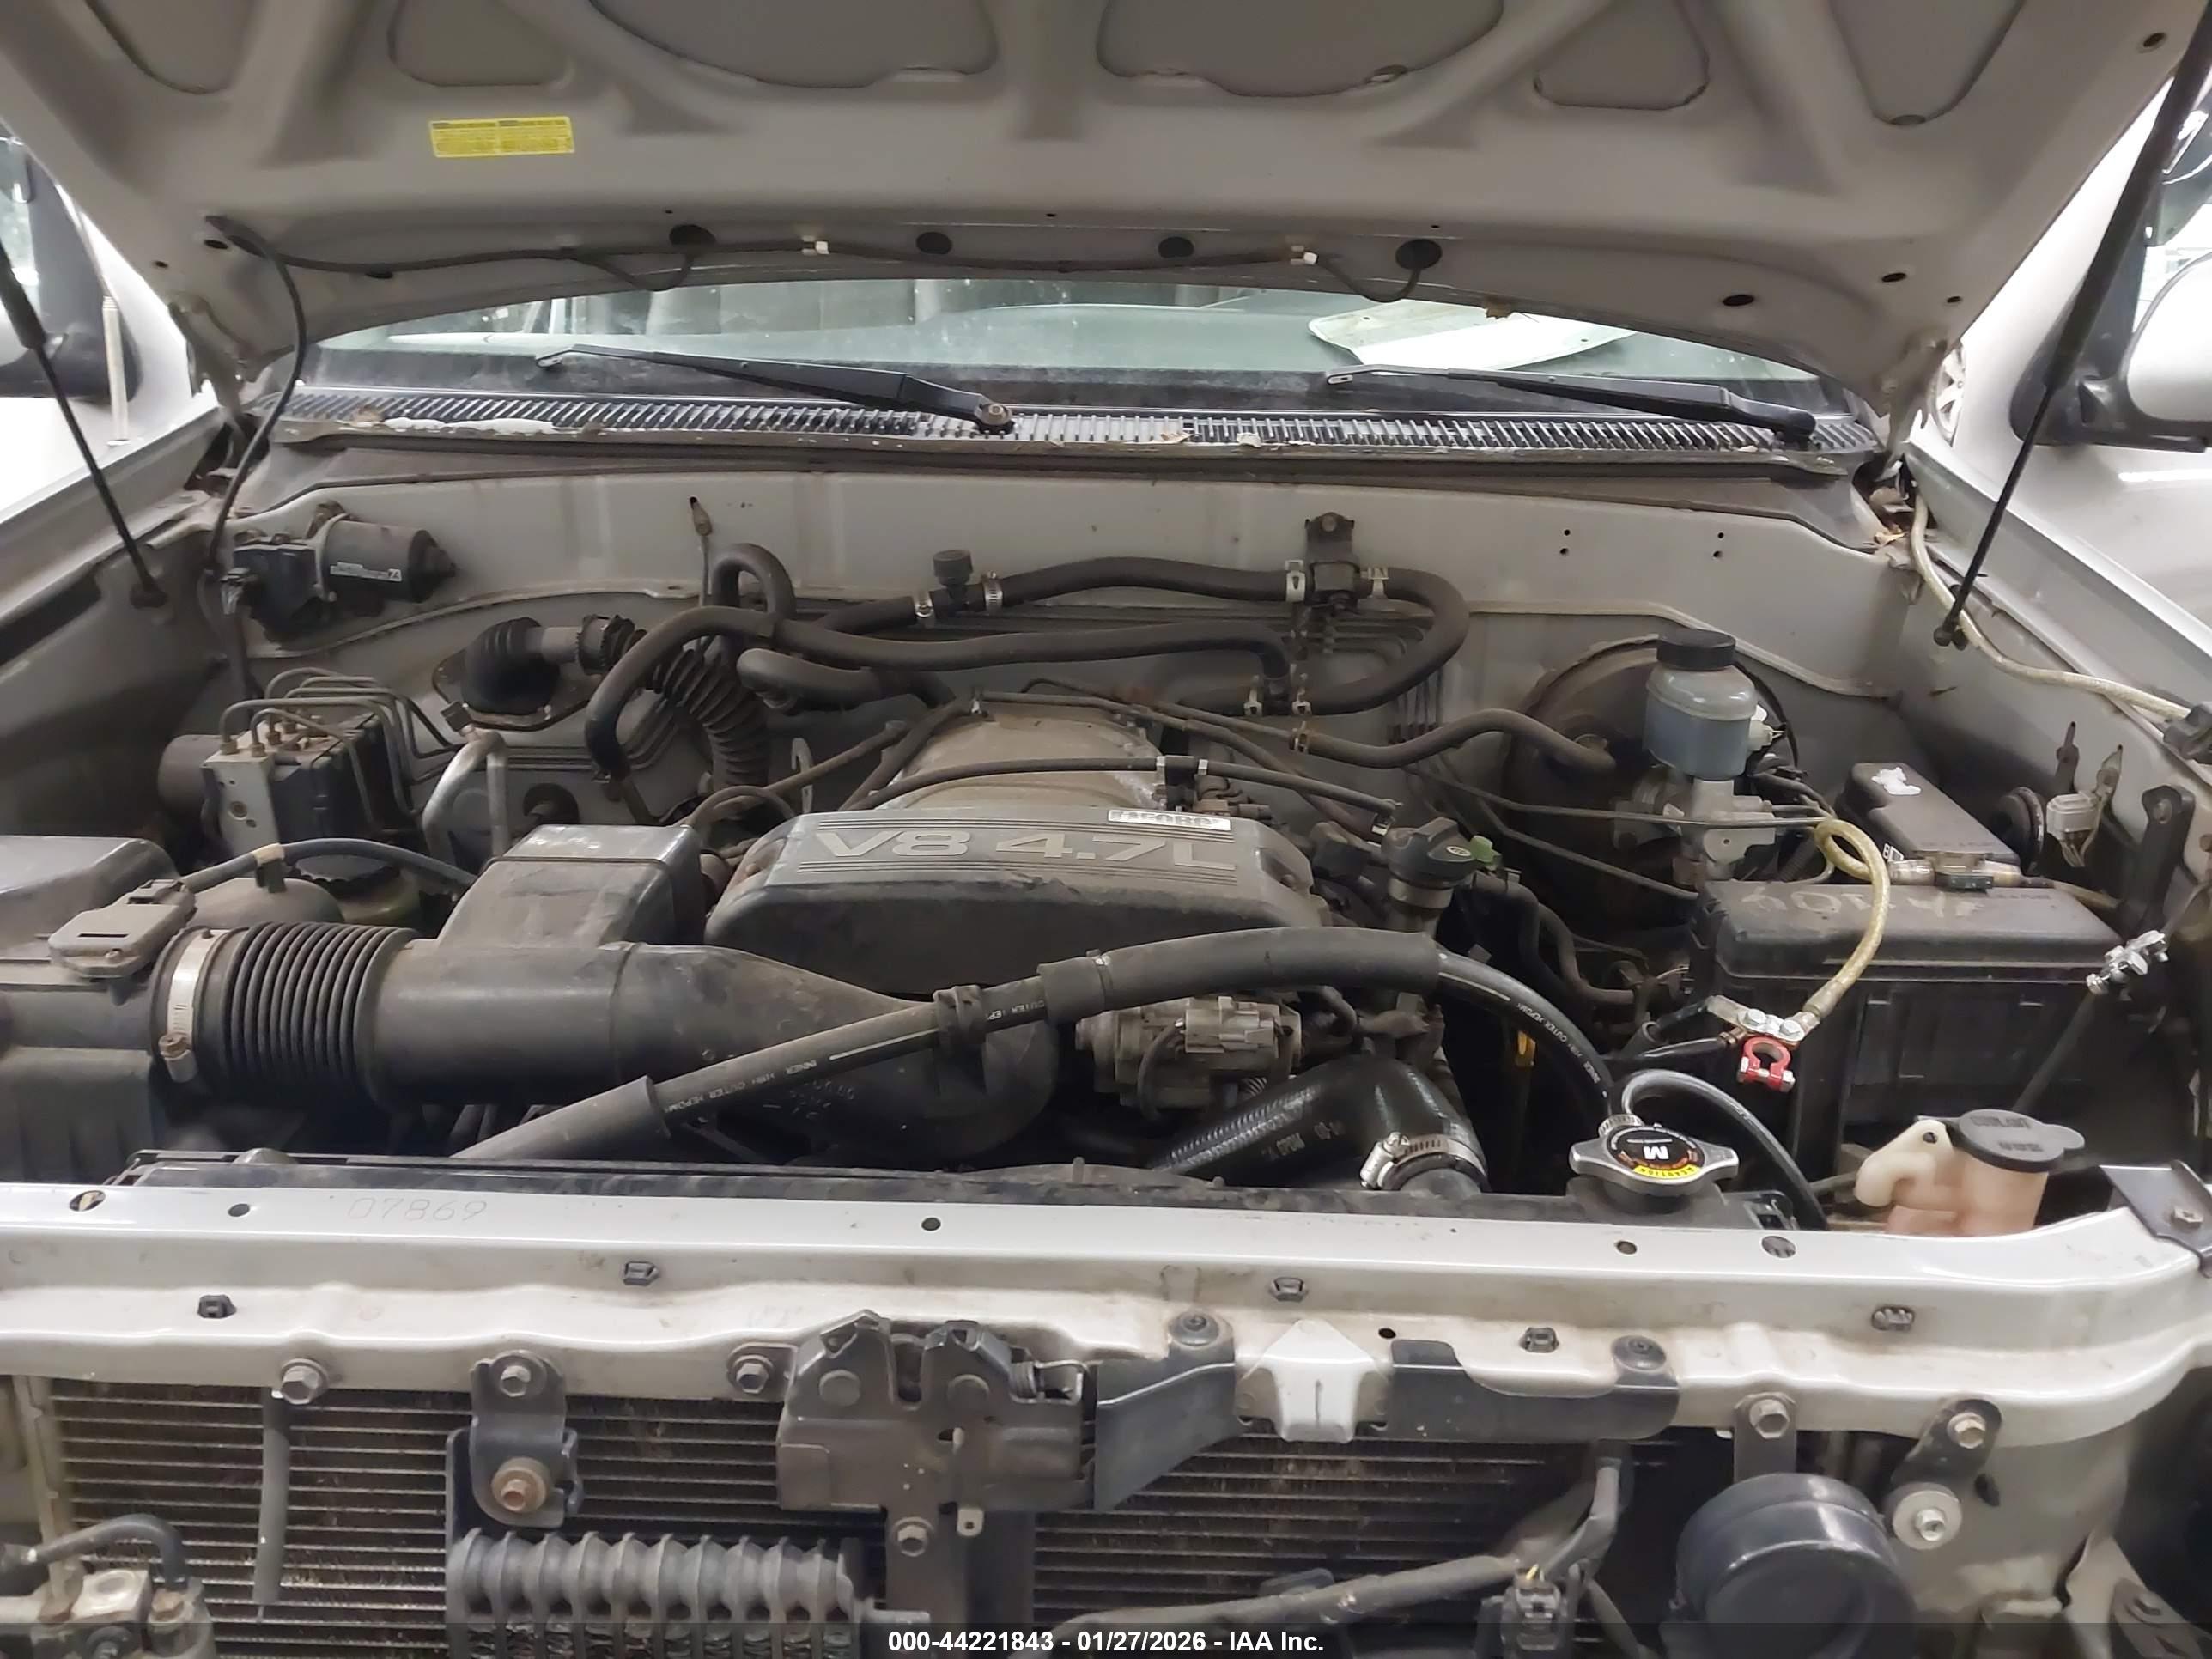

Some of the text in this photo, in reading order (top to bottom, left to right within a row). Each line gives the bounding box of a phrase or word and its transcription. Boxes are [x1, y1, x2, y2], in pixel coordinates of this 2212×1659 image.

[816, 830, 1235, 871] V8 4.7L
[348, 1197, 487, 1221] 07869
